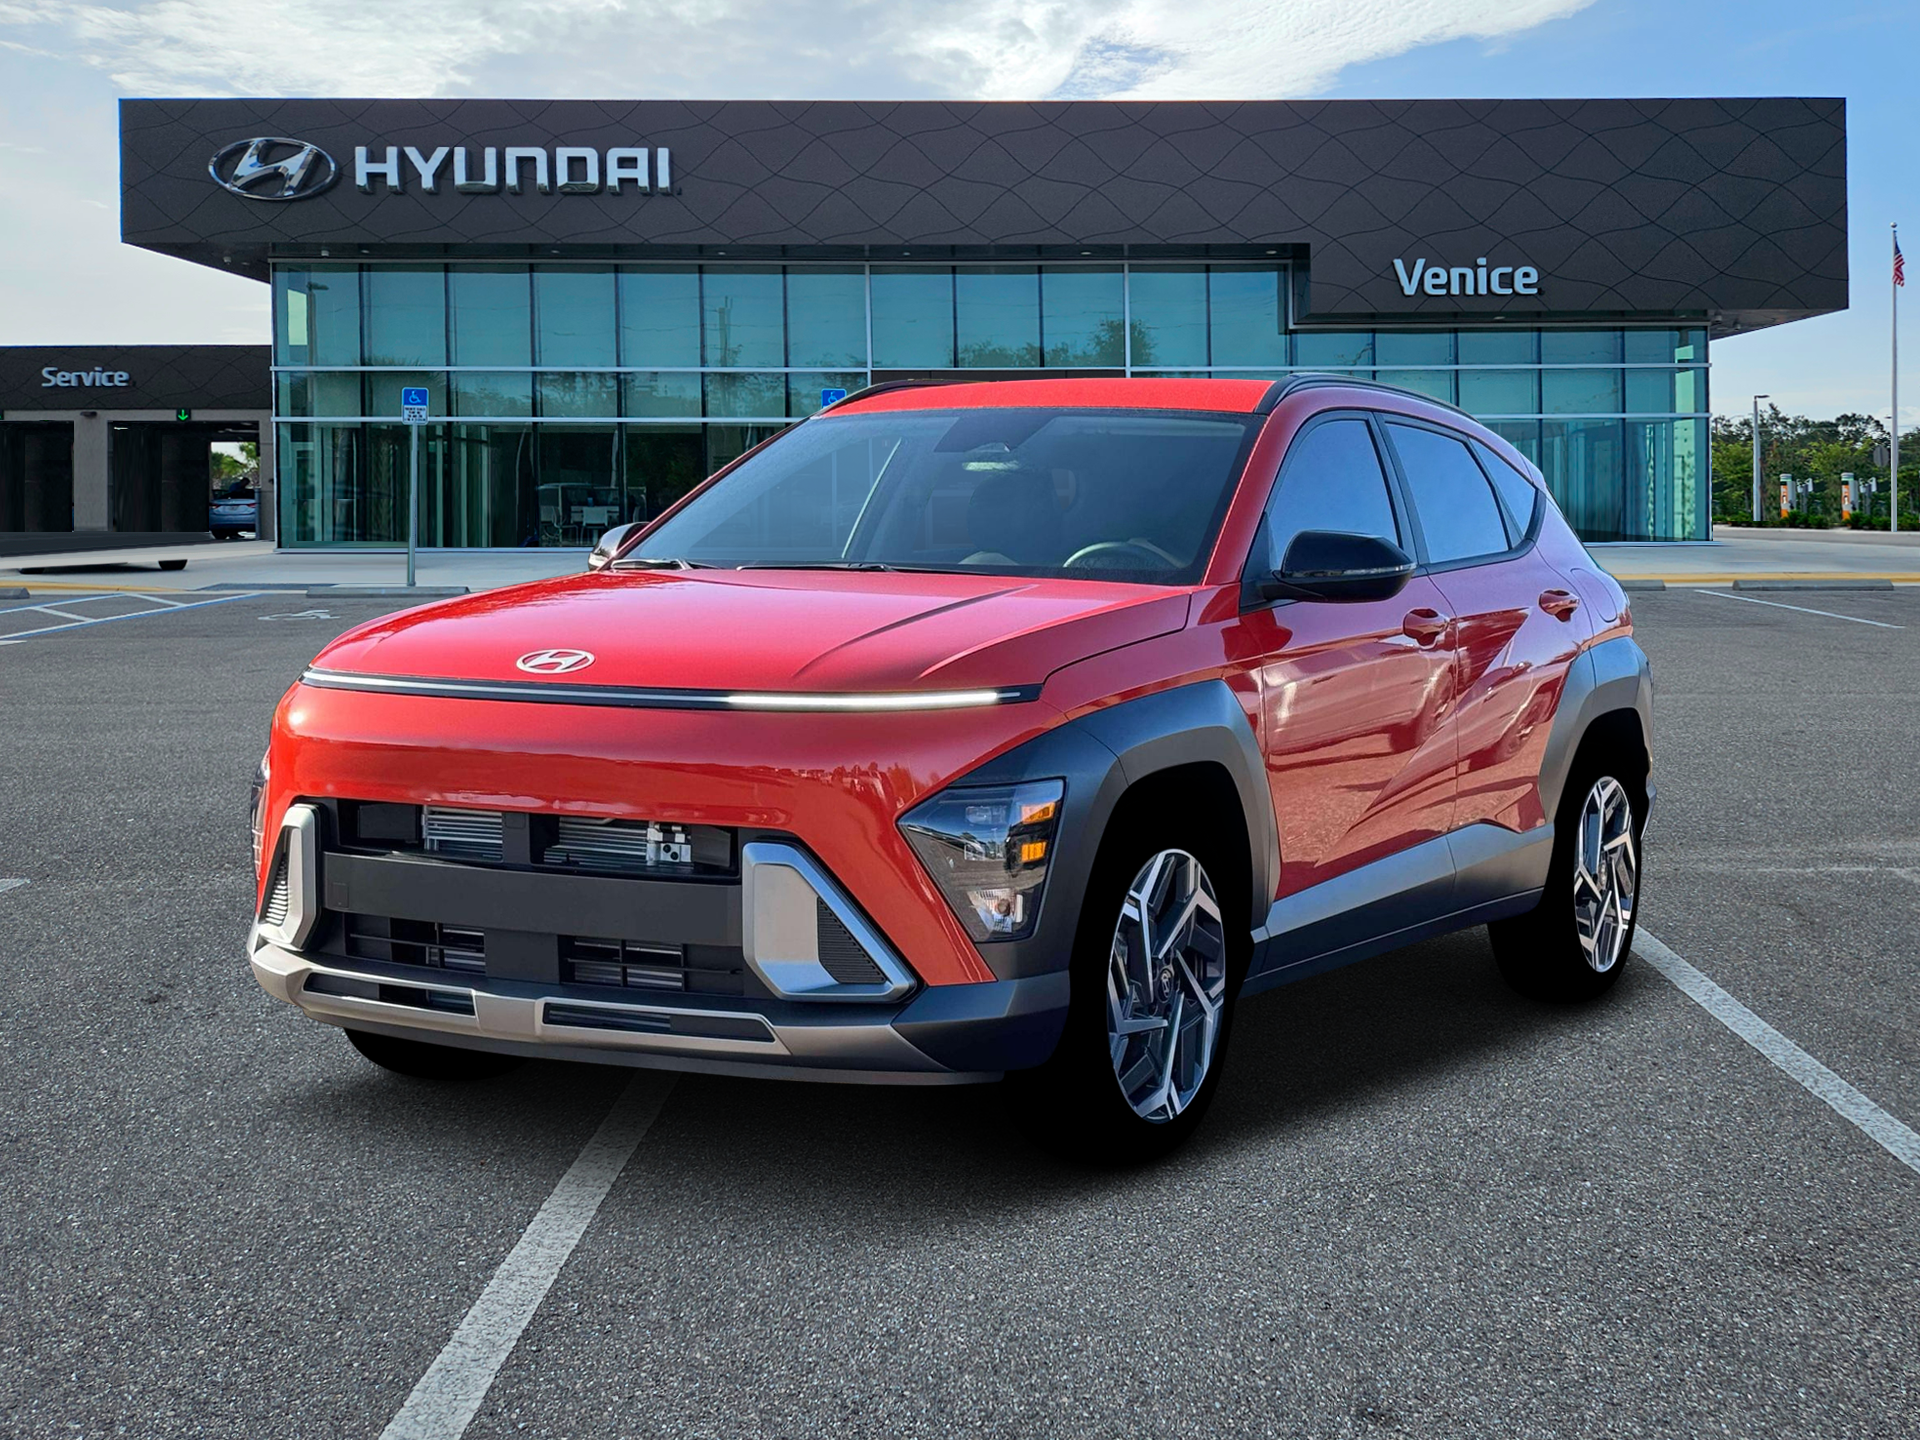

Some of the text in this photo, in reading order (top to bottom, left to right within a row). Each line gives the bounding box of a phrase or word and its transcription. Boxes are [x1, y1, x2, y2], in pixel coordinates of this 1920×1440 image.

[354, 145, 672, 194] HYUNDAI
[1392, 257, 1539, 296] Venice
[41, 366, 130, 388] Service
